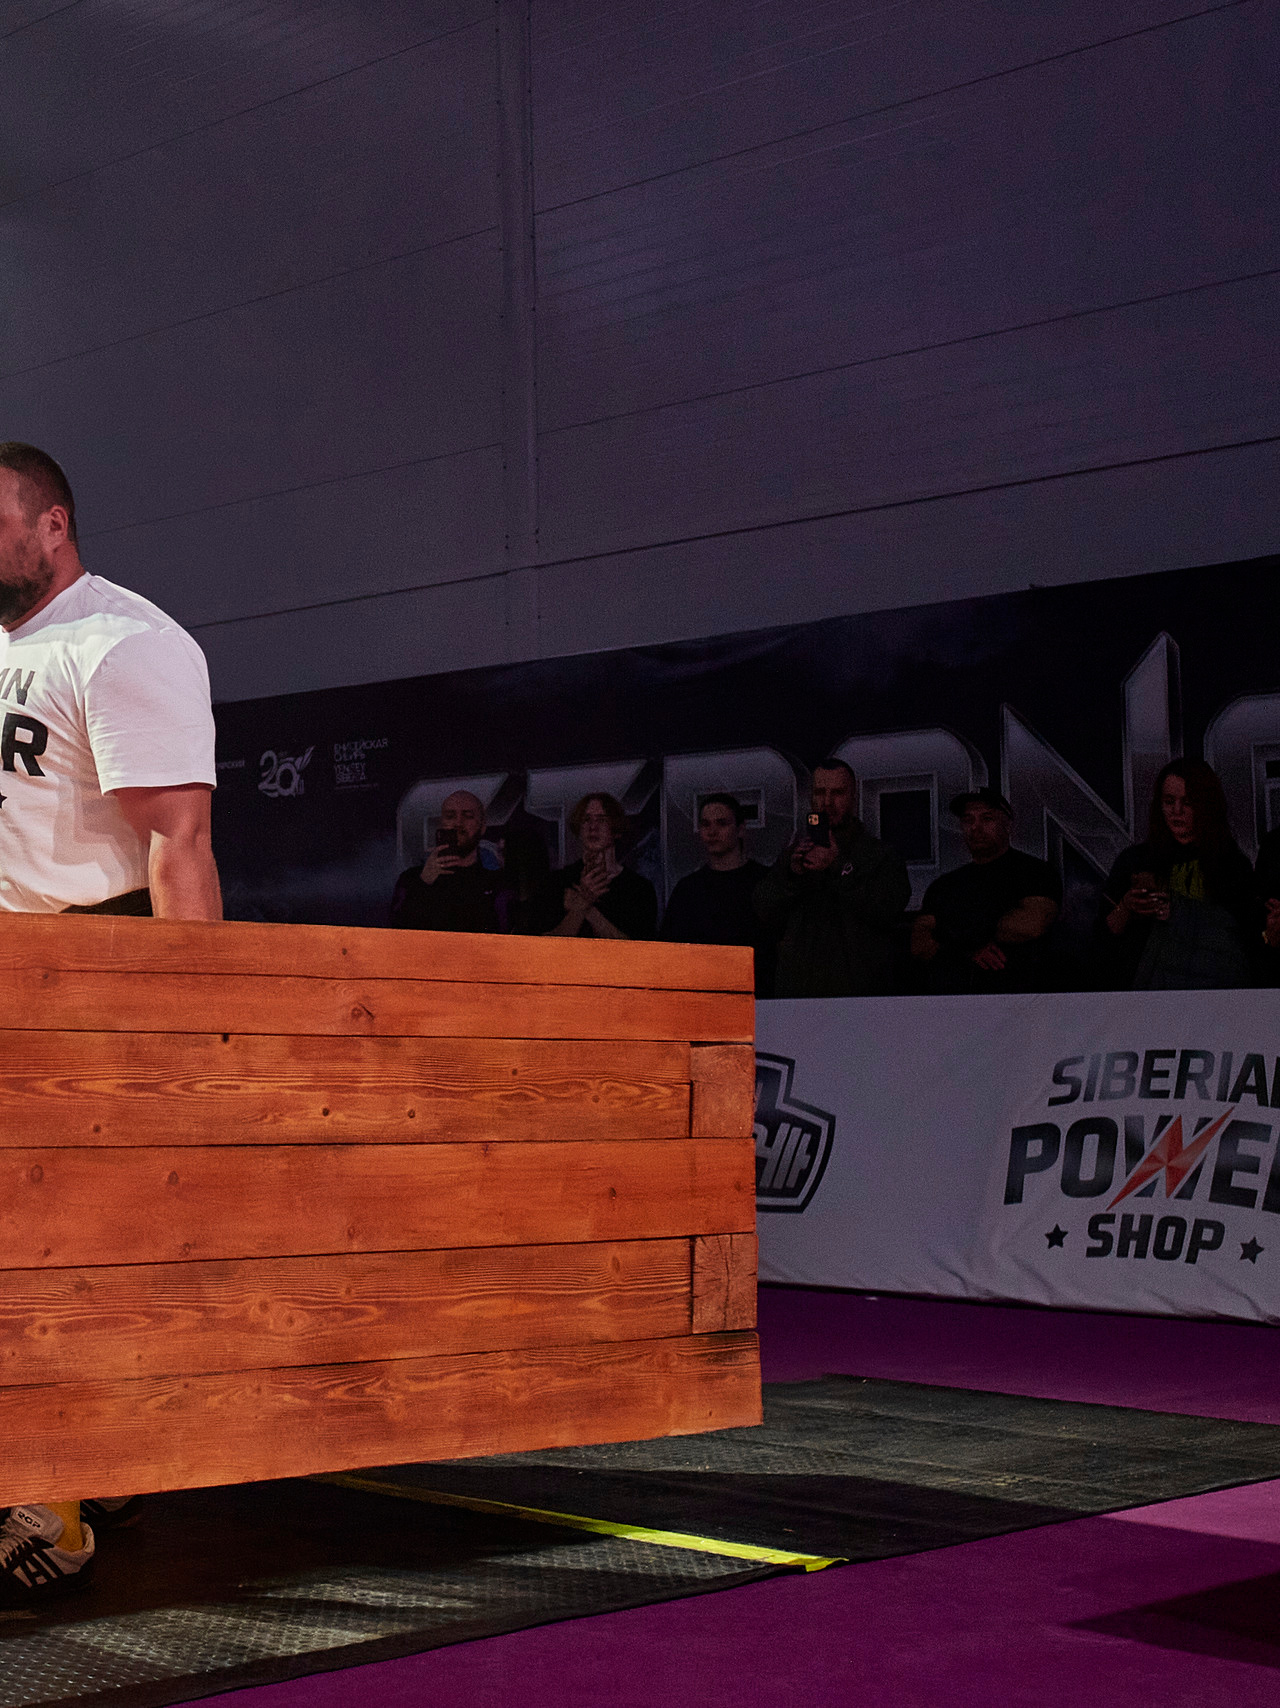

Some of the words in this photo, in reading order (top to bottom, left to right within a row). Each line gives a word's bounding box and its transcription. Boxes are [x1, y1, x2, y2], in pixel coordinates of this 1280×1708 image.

[1047, 1049, 1280, 1109] SIBERIA
[1004, 1112, 1280, 1214] POWE
[1085, 1213, 1226, 1265] SHOP
